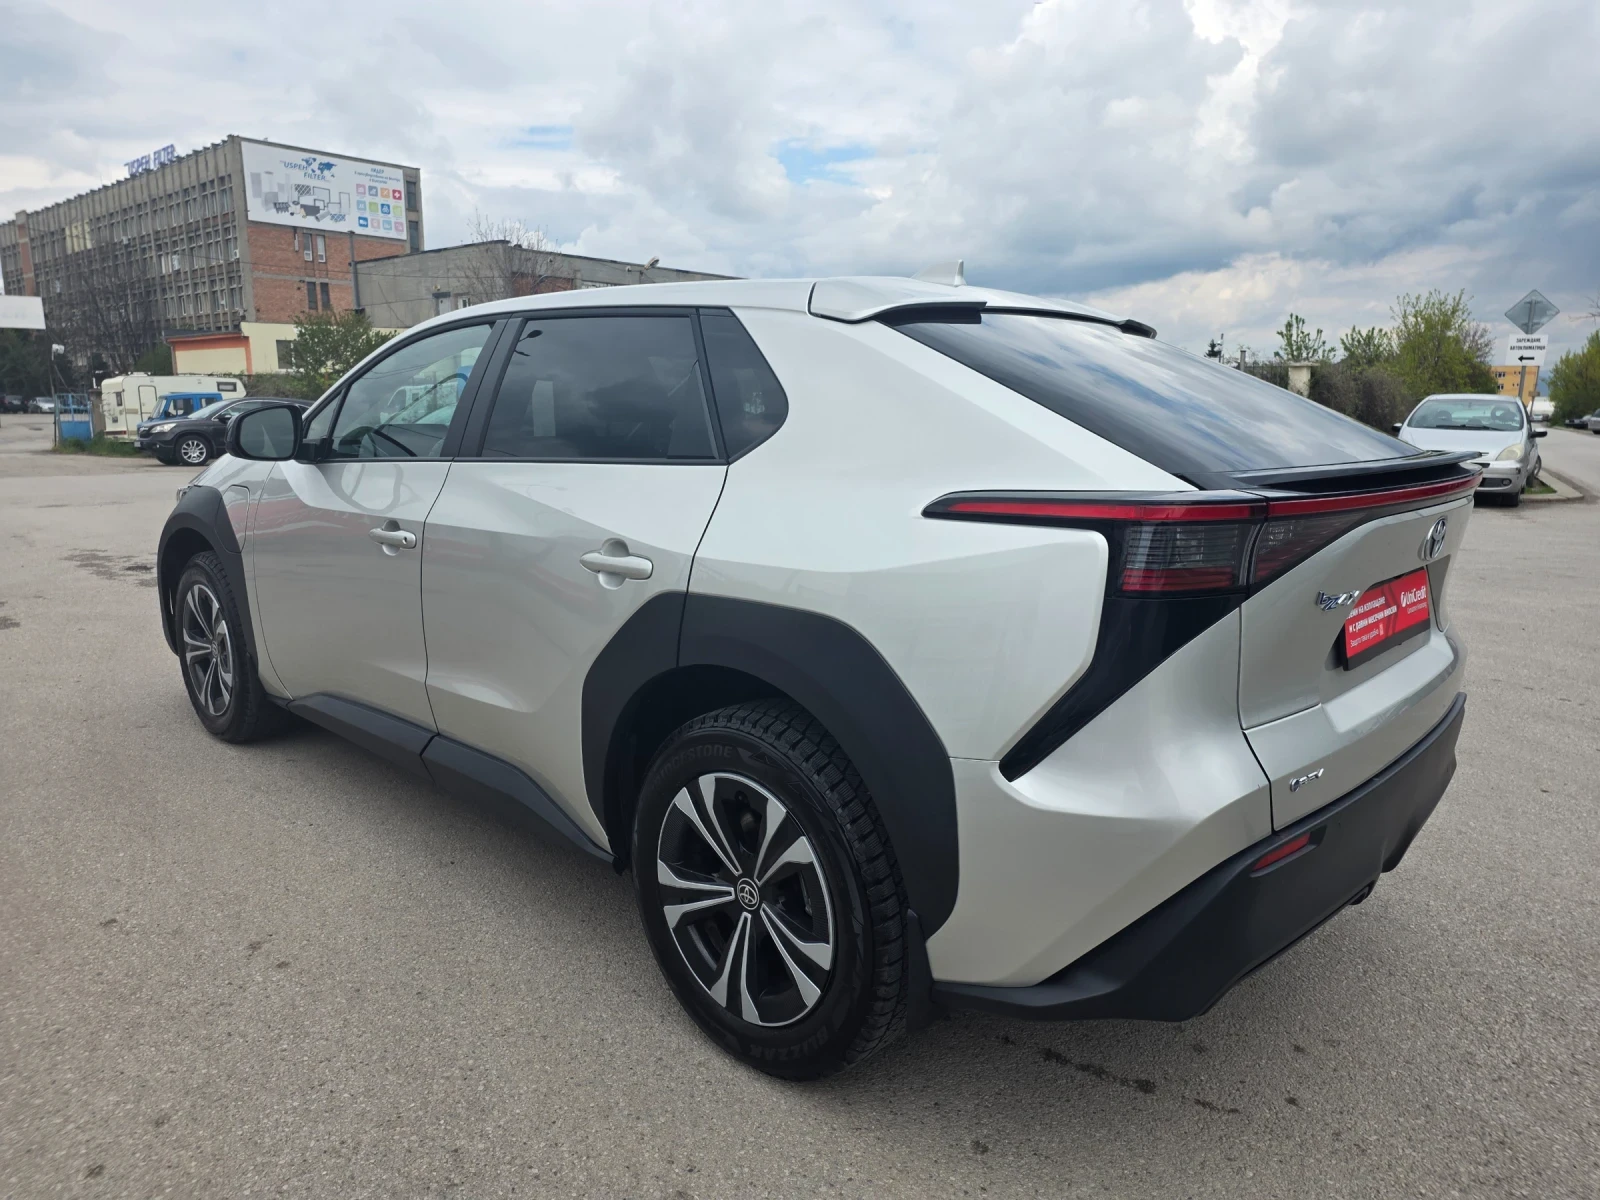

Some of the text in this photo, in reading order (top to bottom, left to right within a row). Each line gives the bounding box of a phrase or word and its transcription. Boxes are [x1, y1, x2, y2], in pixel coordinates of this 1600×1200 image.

[284, 161, 307, 171] USPEH
[303, 172, 326, 180] FILTER
[1405, 585, 1426, 605] UniCredit
[1358, 605, 1364, 614] на
[1364, 596, 1385, 611] изплащане
[1349, 625, 1353, 633] и
[1356, 617, 1368, 633] равни
[1368, 611, 1384, 624] месечни
[1384, 605, 1397, 617] вноски
